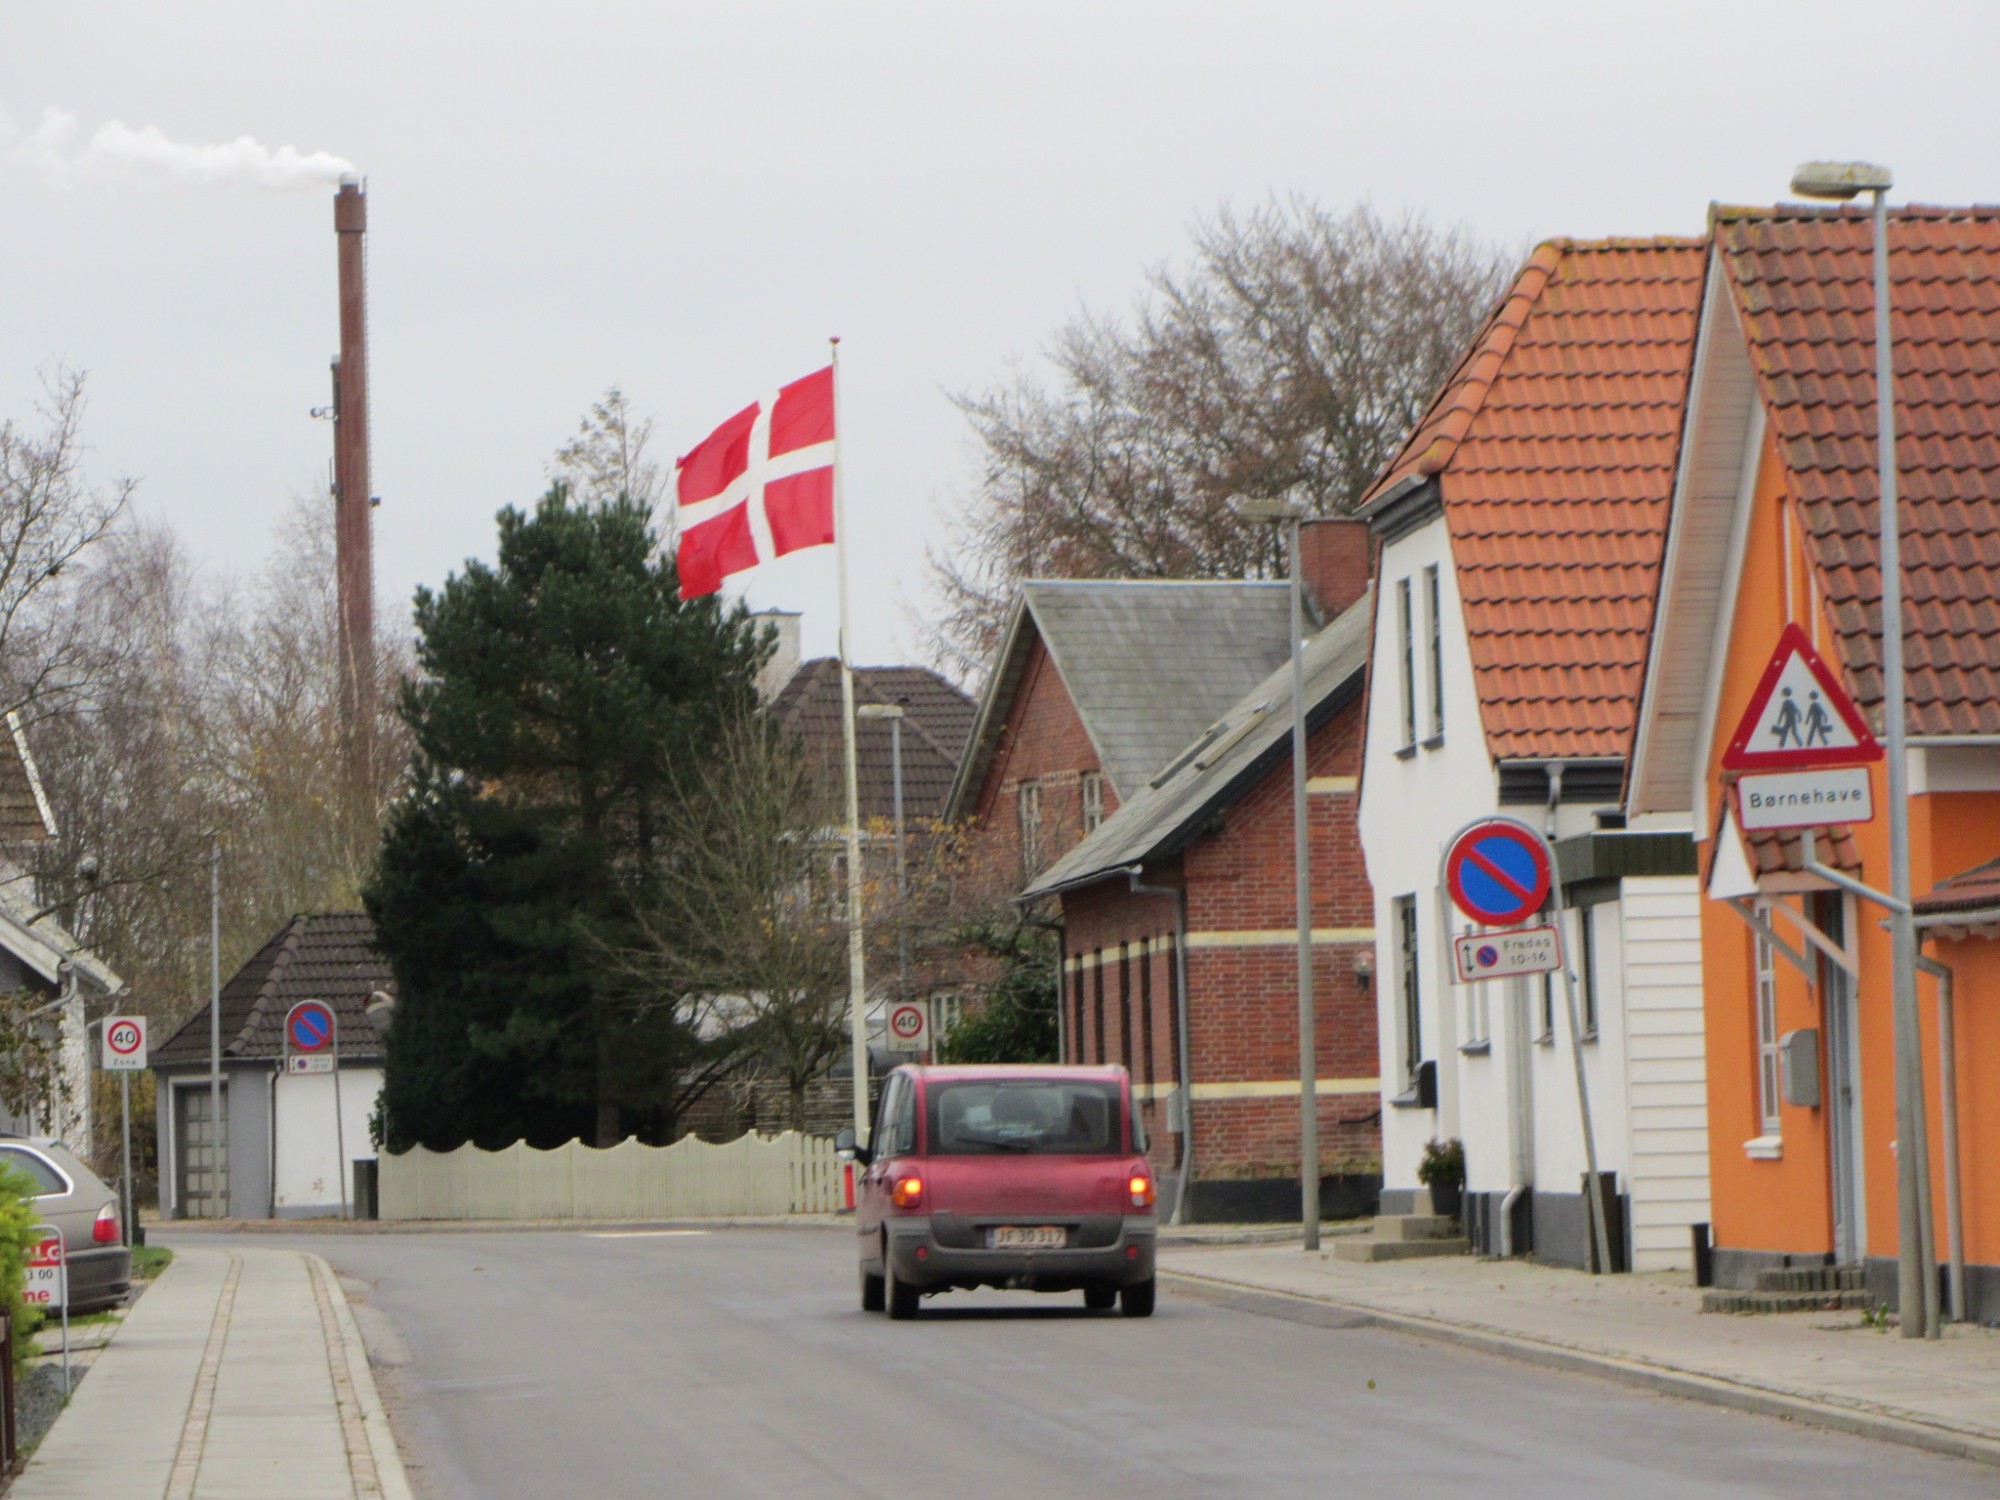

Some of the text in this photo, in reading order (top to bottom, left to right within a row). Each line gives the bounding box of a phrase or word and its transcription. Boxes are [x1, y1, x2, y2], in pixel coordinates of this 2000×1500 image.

[1749, 789, 1862, 809] Børnehave
[1503, 938, 1551, 951] Fredag
[1510, 952, 1547, 965] 10-16
[897, 1015, 918, 1028] 40
[114, 1031, 136, 1044] 40
[113, 1058, 137, 1066] Zone
[39, 1269, 53, 1279] 00
